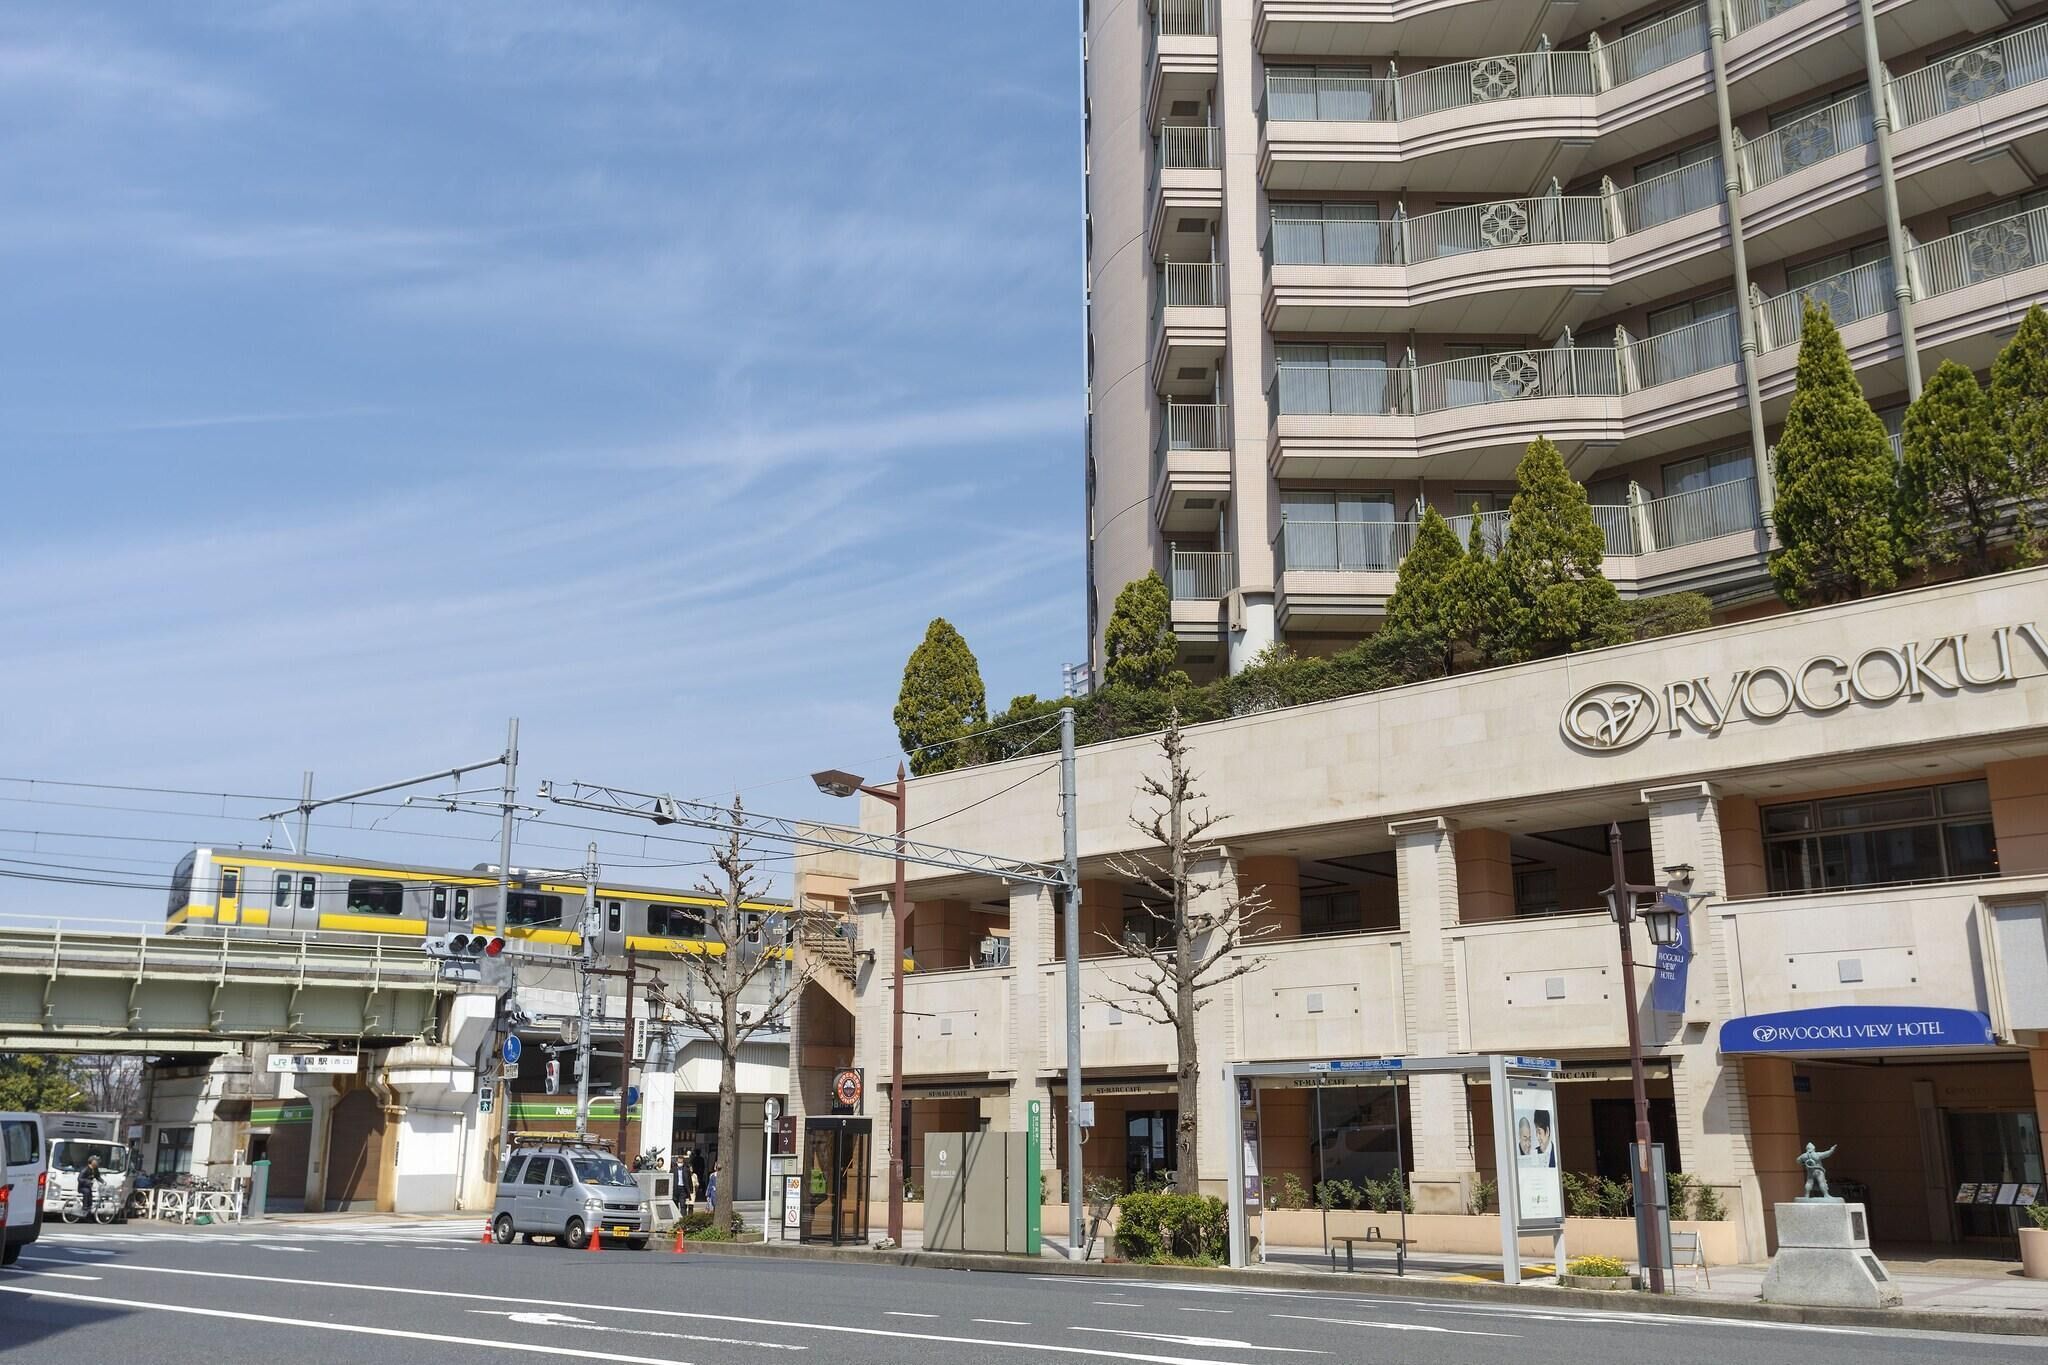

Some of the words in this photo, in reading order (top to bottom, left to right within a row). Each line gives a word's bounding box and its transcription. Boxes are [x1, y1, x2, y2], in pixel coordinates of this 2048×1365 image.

[1665, 627, 2014, 733] RYOGOKU
[1662, 962, 1676, 970] VIEW
[1661, 971, 1675, 980] HOTEL
[1779, 1025, 1851, 1041] RYOGOKU
[1853, 1023, 1893, 1038] VIEW
[1897, 1021, 1945, 1037] HOTEL
[274, 1058, 287, 1067] JR
